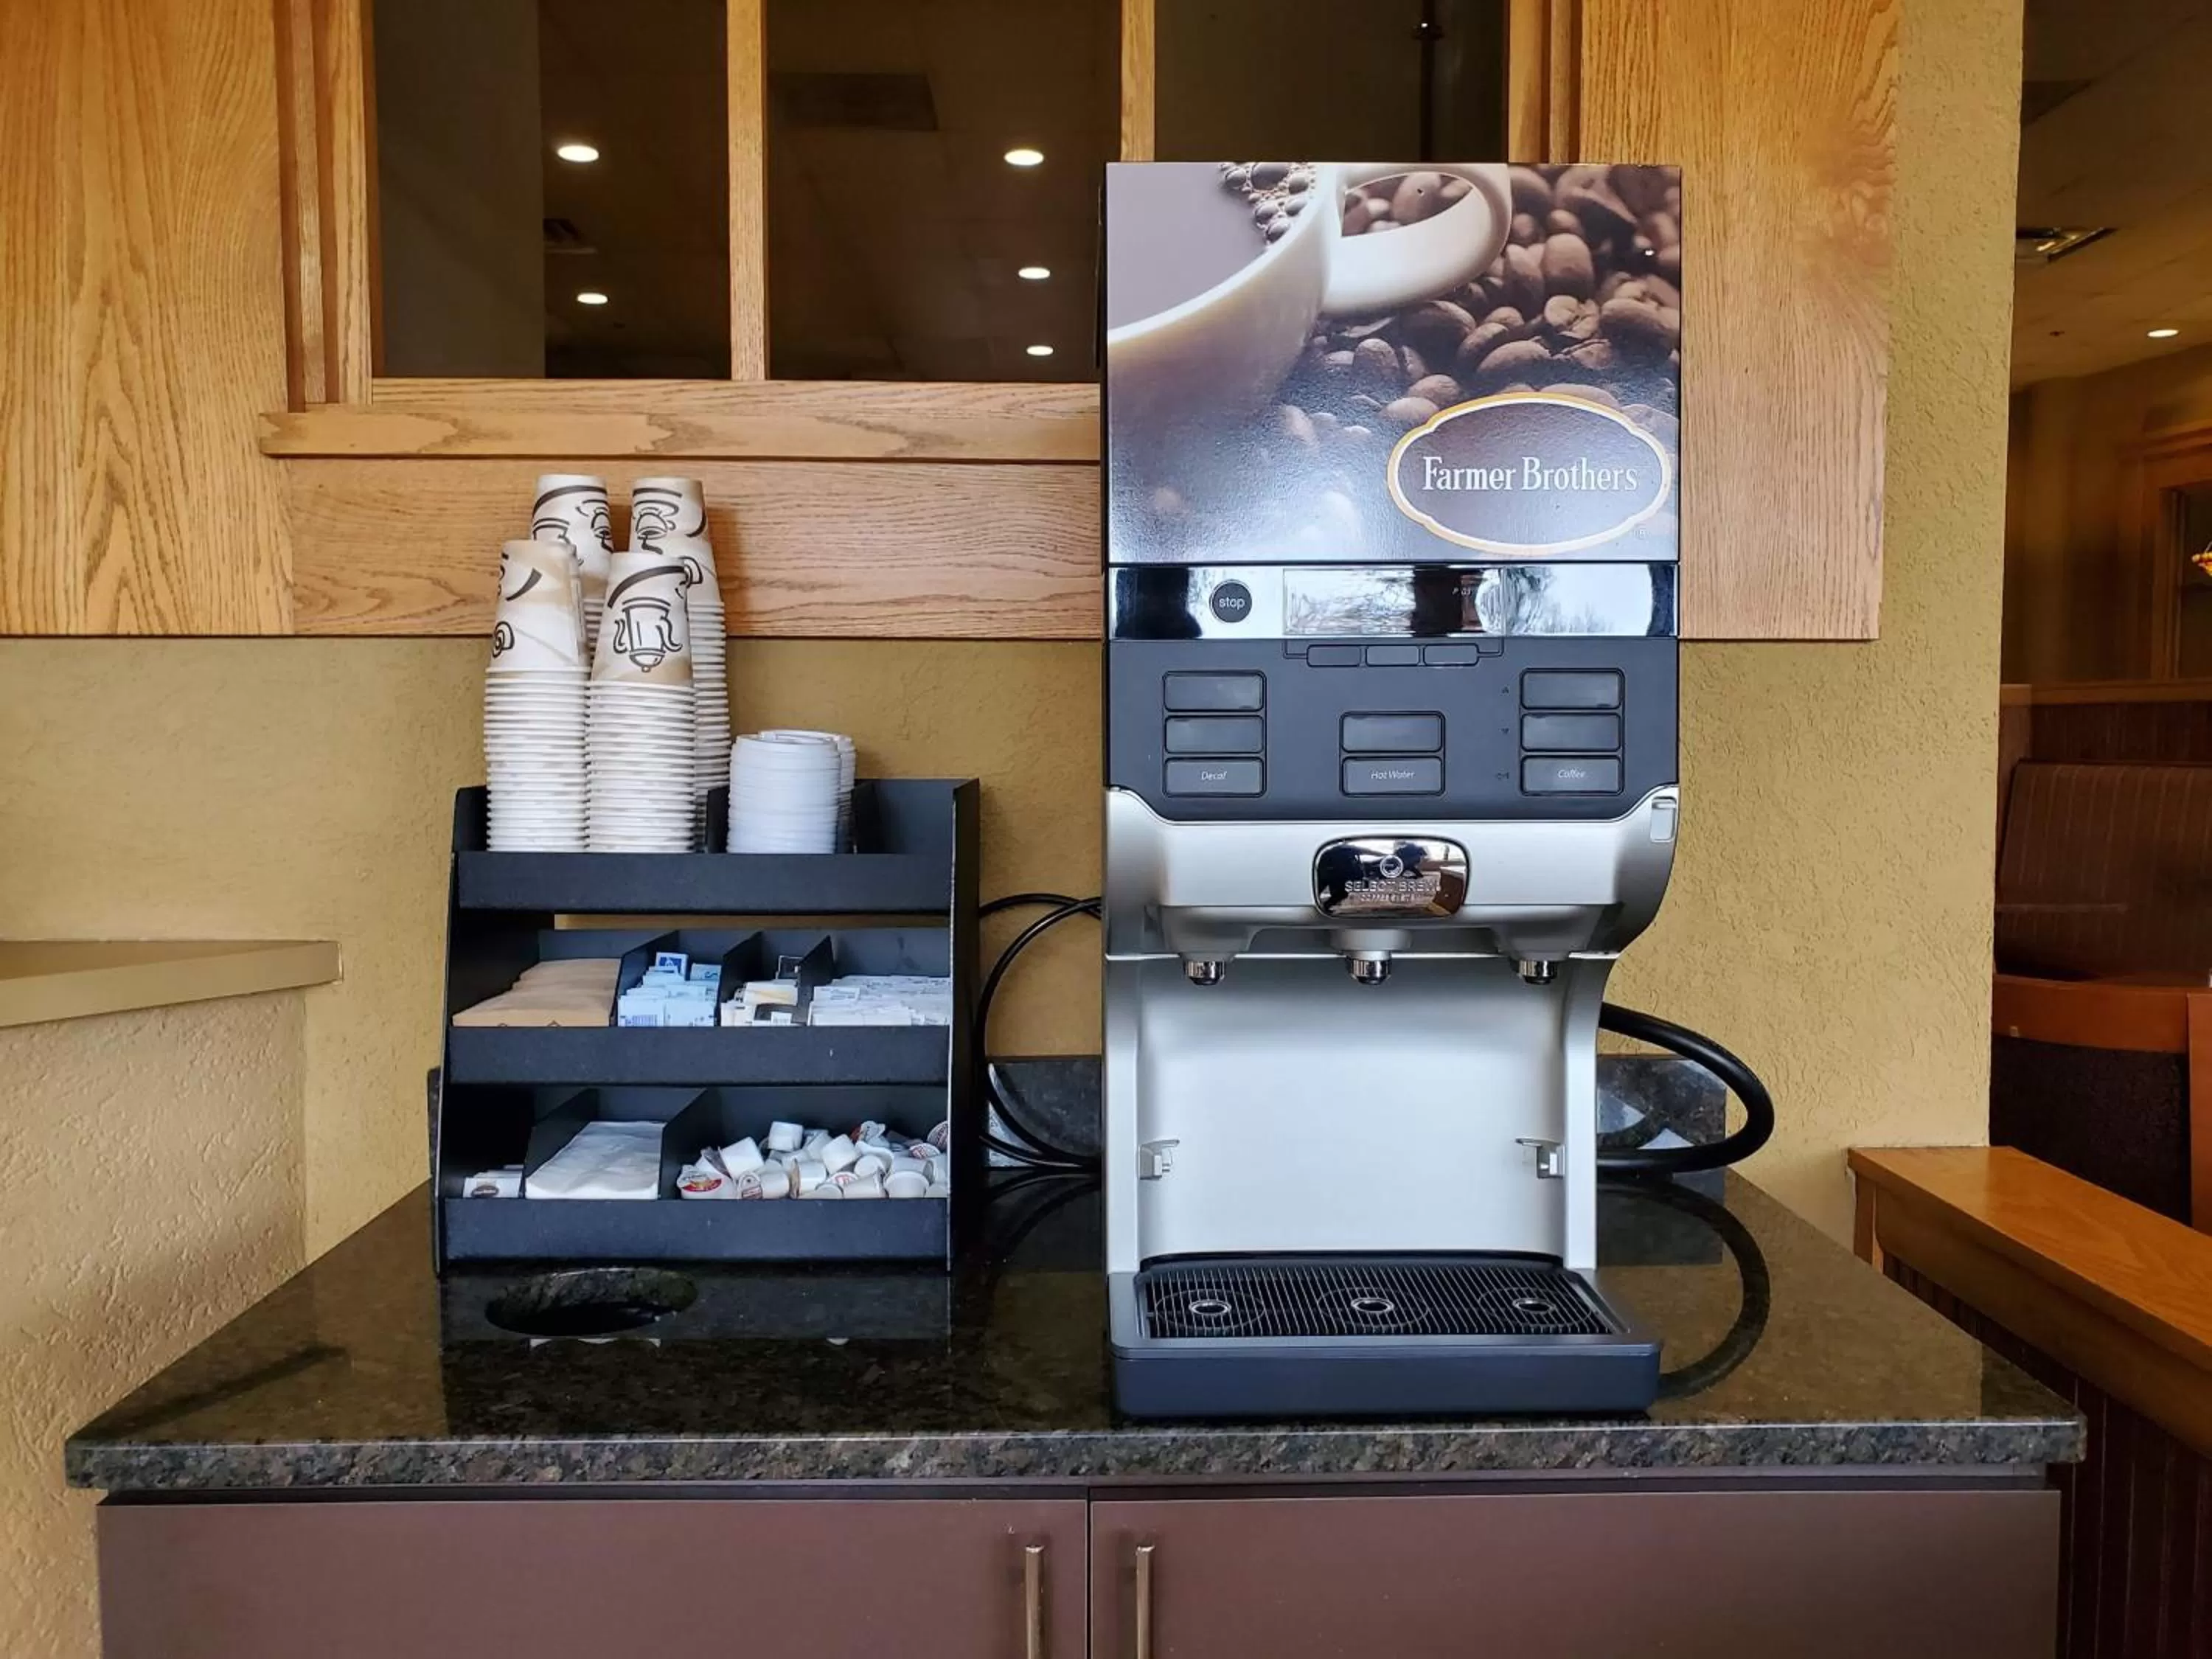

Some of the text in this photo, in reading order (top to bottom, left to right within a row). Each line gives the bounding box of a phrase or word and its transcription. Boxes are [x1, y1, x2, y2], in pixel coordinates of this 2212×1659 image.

[1422, 456, 1638, 490] Farmer Brothers
[1218, 596, 1245, 611] stop
[1200, 770, 1228, 780] Decaf
[1371, 769, 1415, 779] Hot Water
[1557, 768, 1585, 779] Coffee
